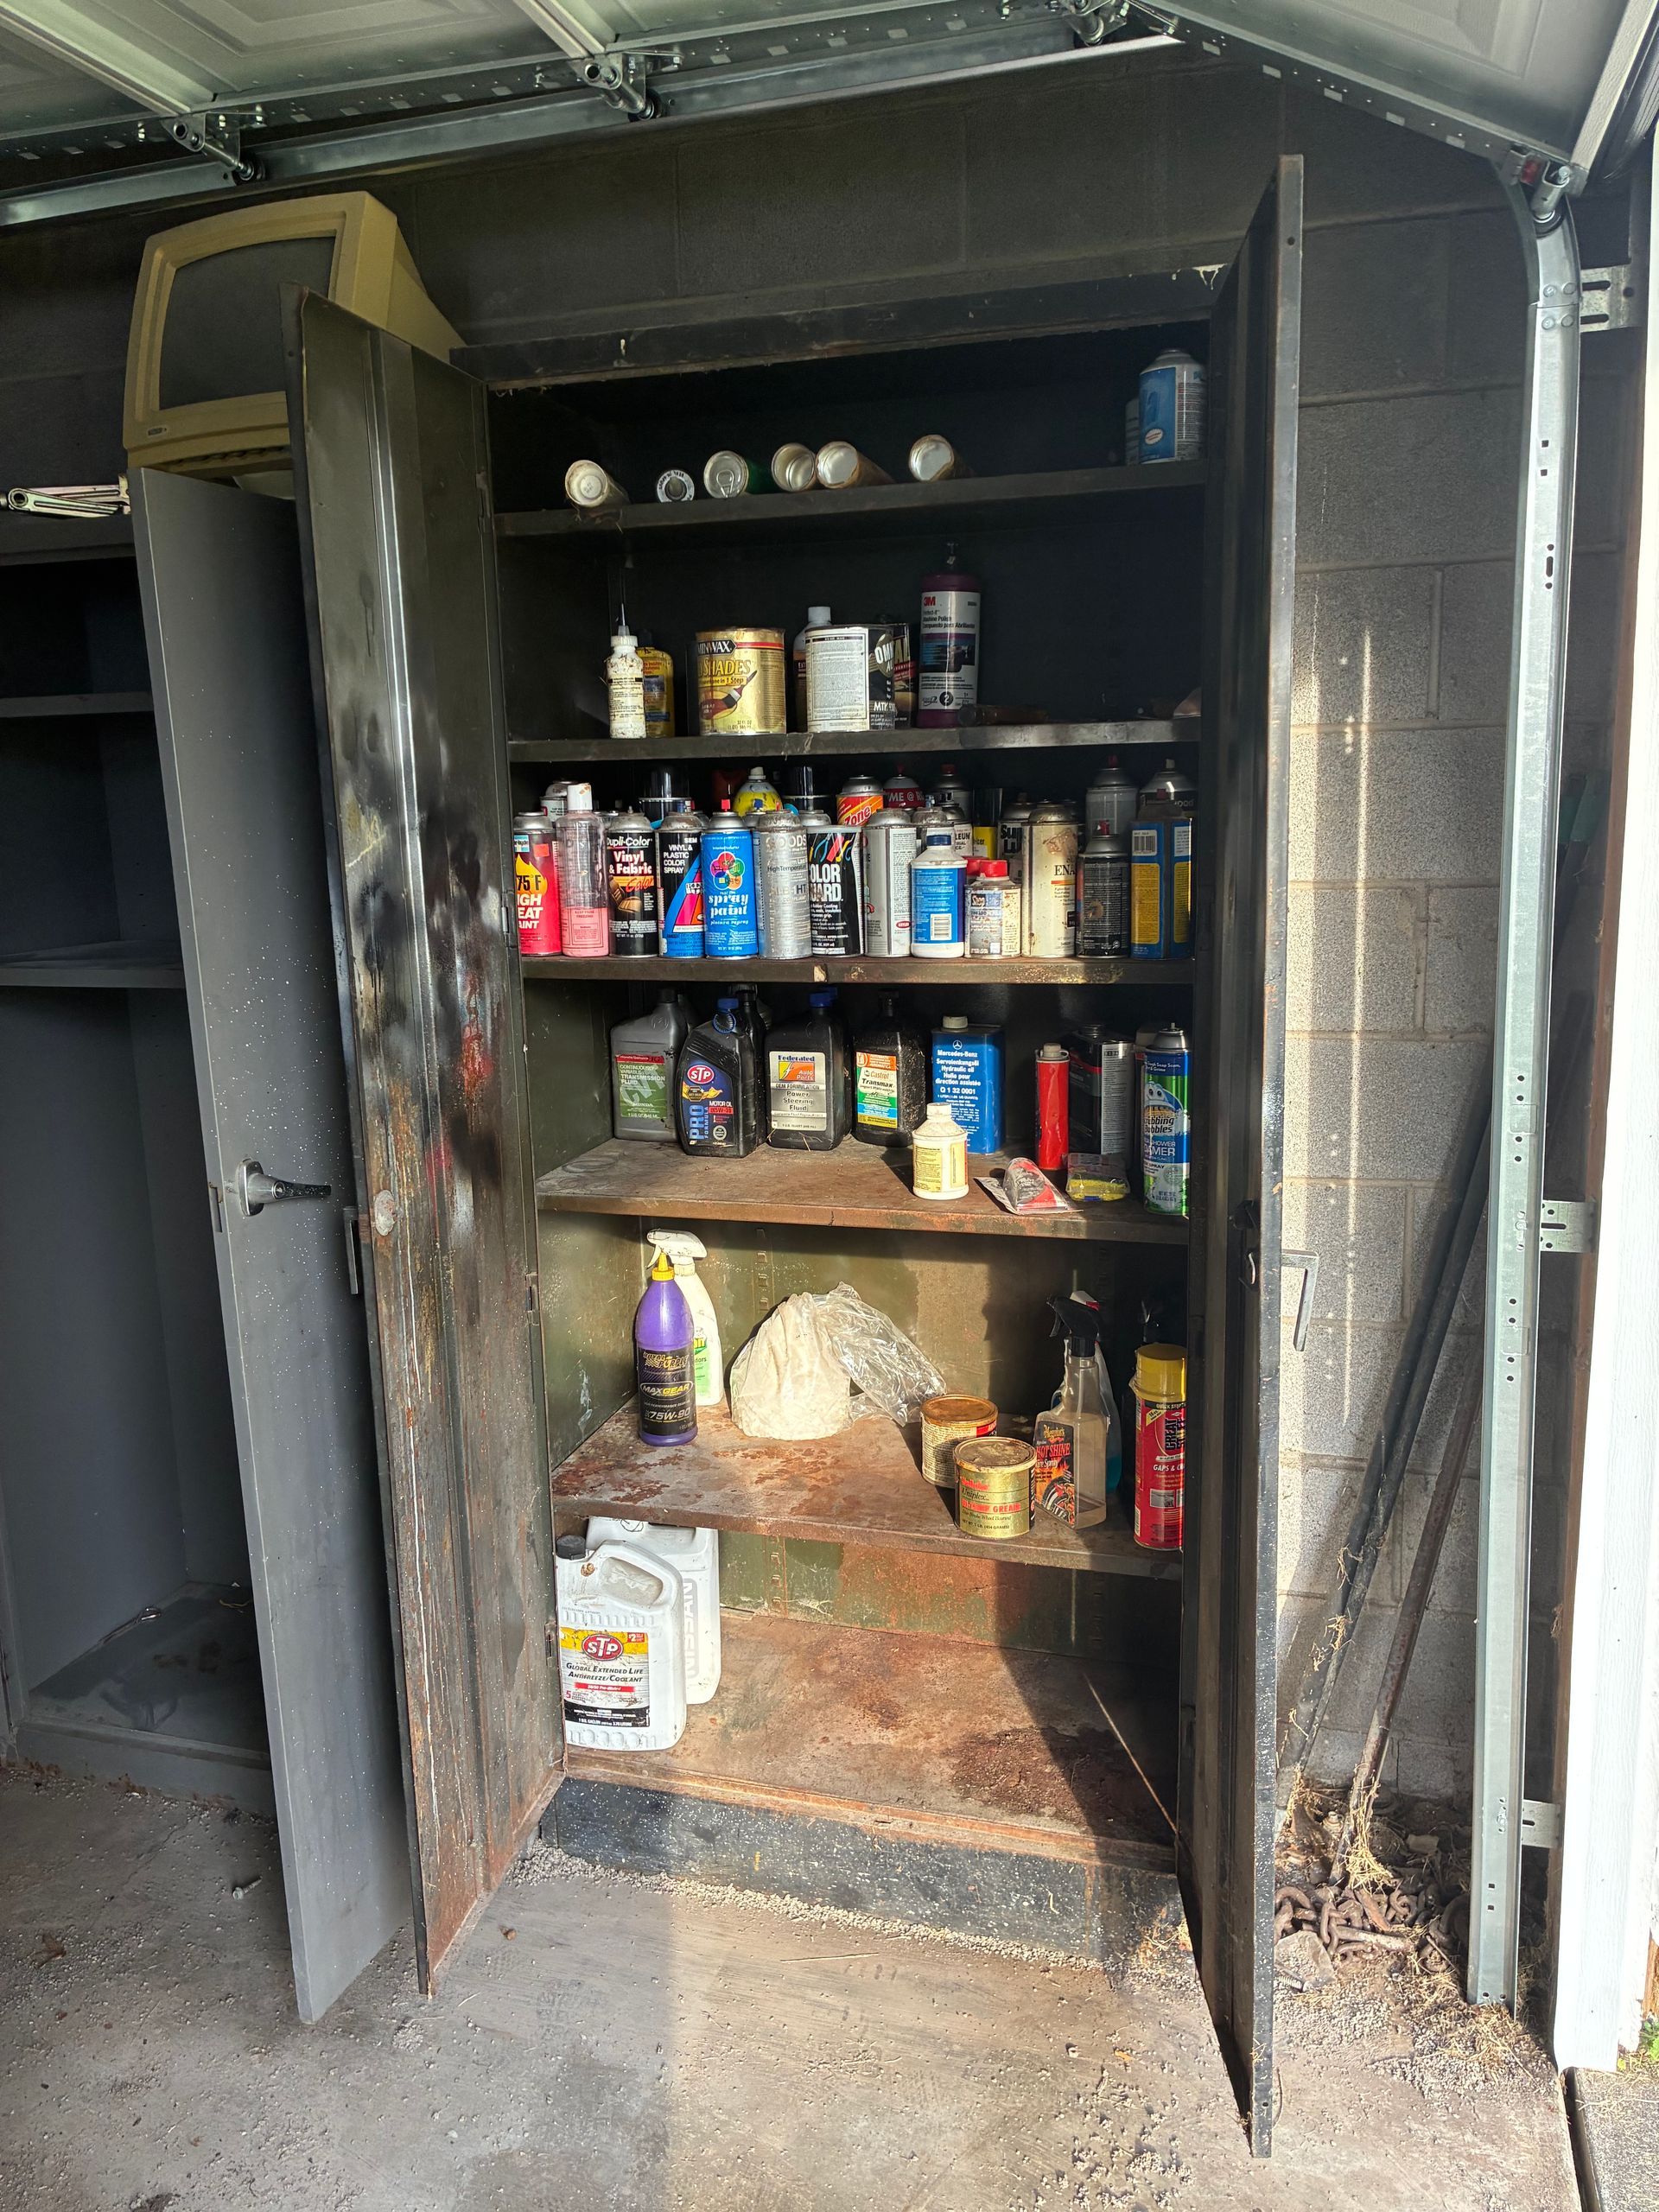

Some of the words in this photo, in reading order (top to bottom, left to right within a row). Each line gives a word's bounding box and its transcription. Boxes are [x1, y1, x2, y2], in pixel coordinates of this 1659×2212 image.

[924, 596, 936, 607] 3M
[730, 676, 744, 684] Step
[944, 694, 950, 703] 2
[906, 792, 914, 802] @
[844, 805, 872, 827] Zone
[613, 850, 645, 865] Vinyl
[608, 866, 615, 874] &
[616, 862, 652, 874] Fabric
[810, 863, 841, 883] OLOR
[625, 877, 652, 893] Color
[796, 884, 806, 894] HT
[810, 883, 844, 902] UARD.
[517, 893, 542, 906] IGH
[708, 893, 748, 906] spray
[518, 907, 543, 919] EAT
[710, 905, 747, 919] paint
[518, 920, 540, 929] AINT
[937, 1049, 978, 1058] Mercedes-Benz
[690, 1067, 712, 1082] STP
[870, 1071, 890, 1079] Castrol
[861, 1077, 893, 1088] Transmax
[690, 1104, 705, 1140] PRO
[658, 1354, 690, 1369] PURPLE
[650, 1407, 690, 1421] 75W-90
[1036, 1446, 1050, 1459] HOT
[1049, 1443, 1071, 1458] SHINE
[1044, 1459, 1058, 1469] Spray
[587, 1637, 619, 1657] STP
[566, 1662, 591, 1672] GLOBAL
[593, 1666, 628, 1675] EXTENDED
[568, 1671, 643, 1682] ANTIFREEZE/COOLANT
[566, 1690, 572, 1699] 5
